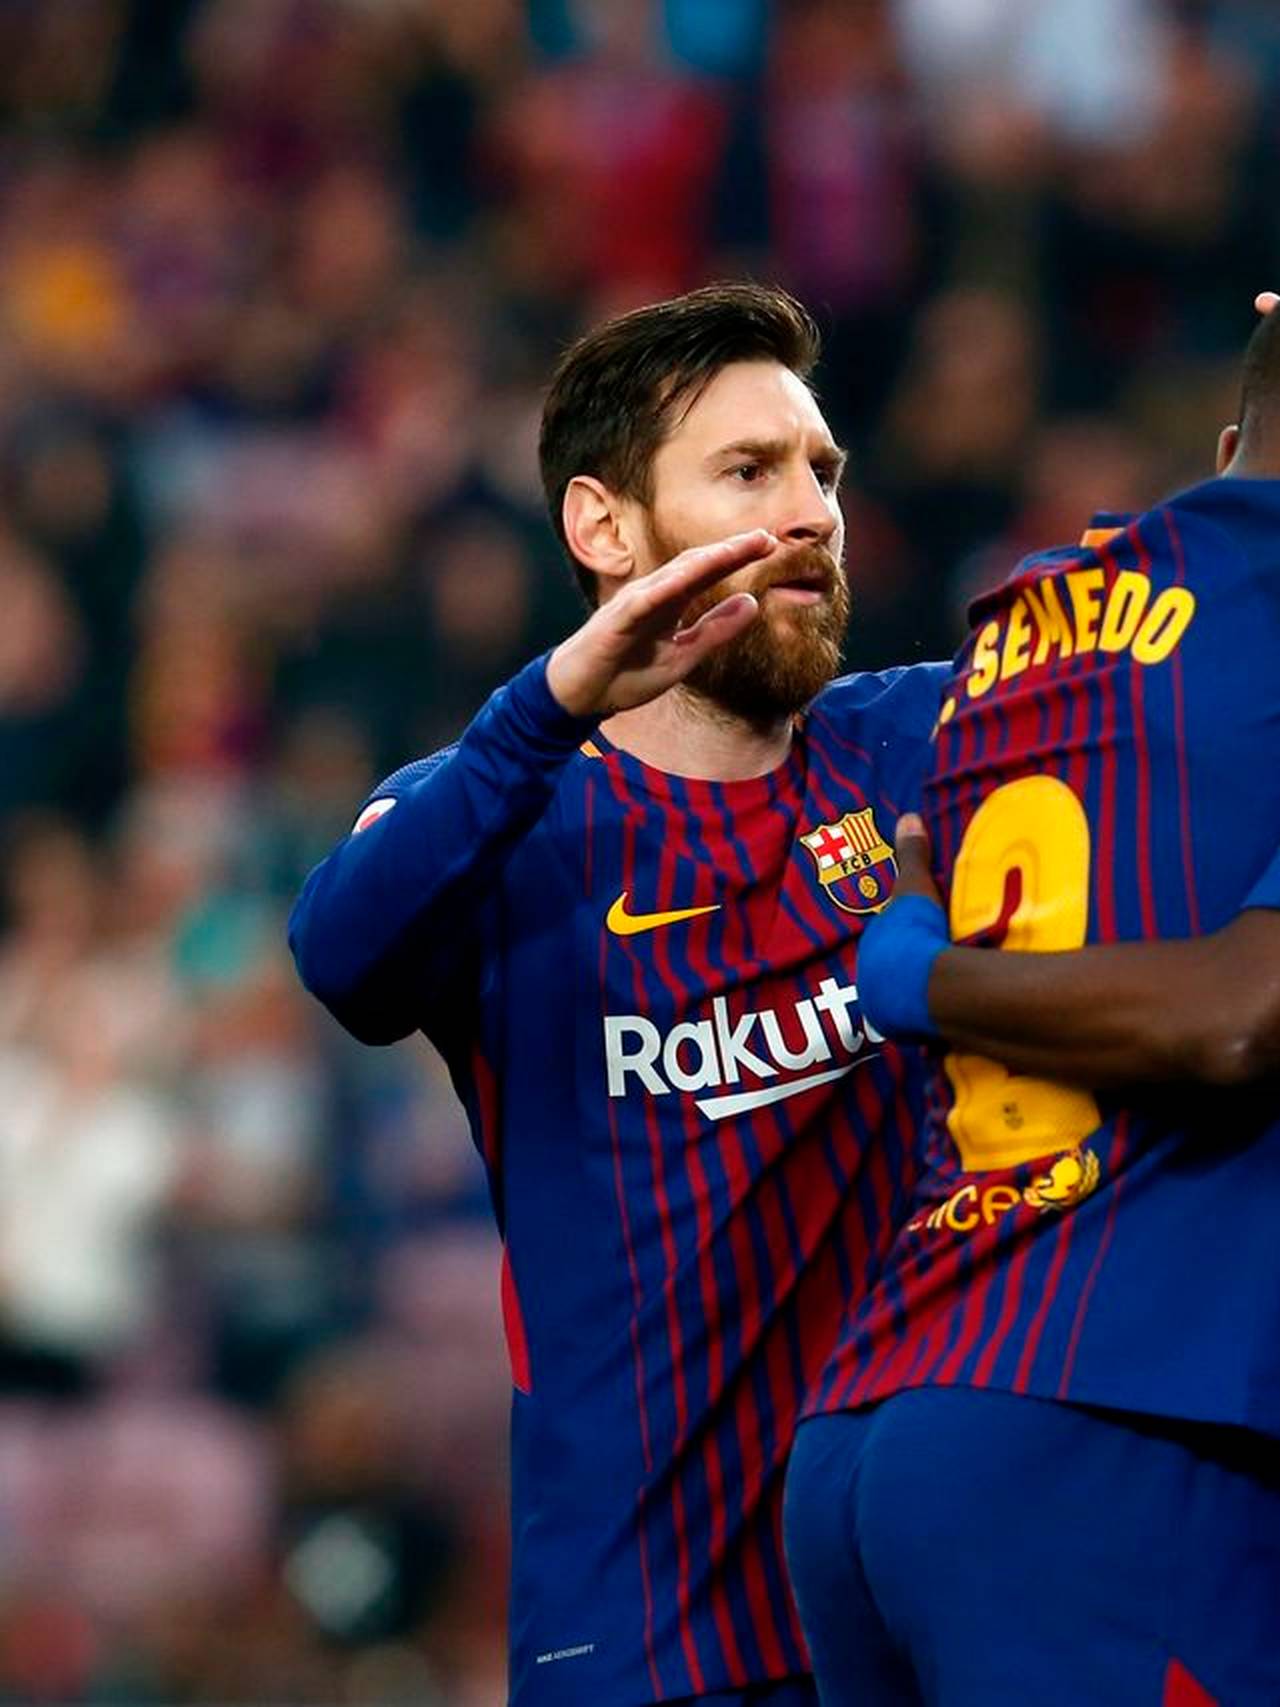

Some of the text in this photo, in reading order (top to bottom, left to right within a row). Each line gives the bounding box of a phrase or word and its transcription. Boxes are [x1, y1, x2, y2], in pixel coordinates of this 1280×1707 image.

[967, 569, 1196, 699] SEMEDO
[841, 853, 872, 875] FCB
[604, 977, 887, 1097] Rakut
